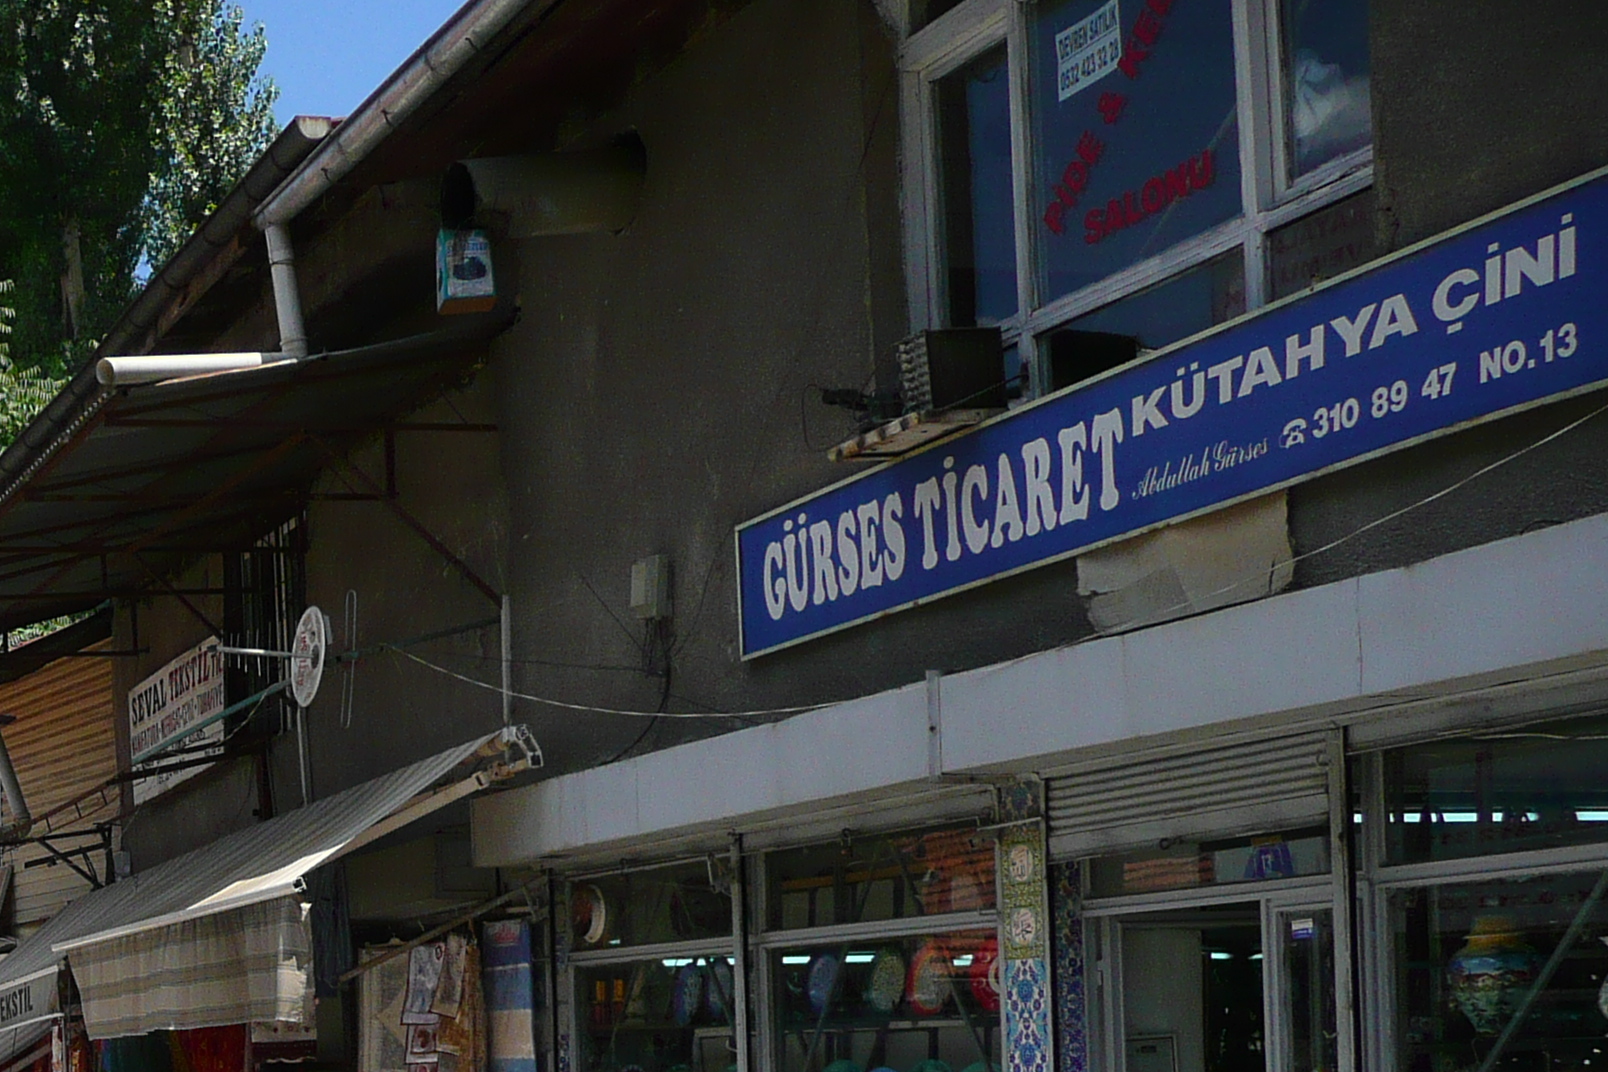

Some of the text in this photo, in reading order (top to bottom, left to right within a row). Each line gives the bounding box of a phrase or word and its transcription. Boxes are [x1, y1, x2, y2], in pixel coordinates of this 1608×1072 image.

[1084, 149, 1214, 245] SALONU
[1130, 293, 1419, 438] KÜTAHYA
[1432, 212, 1577, 334] ÇİNİ
[1312, 397, 1360, 440] 310
[1370, 380, 1409, 420] 89
[1420, 363, 1458, 400] 47
[1131, 438, 1270, 500] Abdullah Gürses
[763, 407, 1124, 620] GÜRSES TİCARET
[131, 678, 168, 725] SEVAL
[168, 645, 210, 702] TEKSTİL
